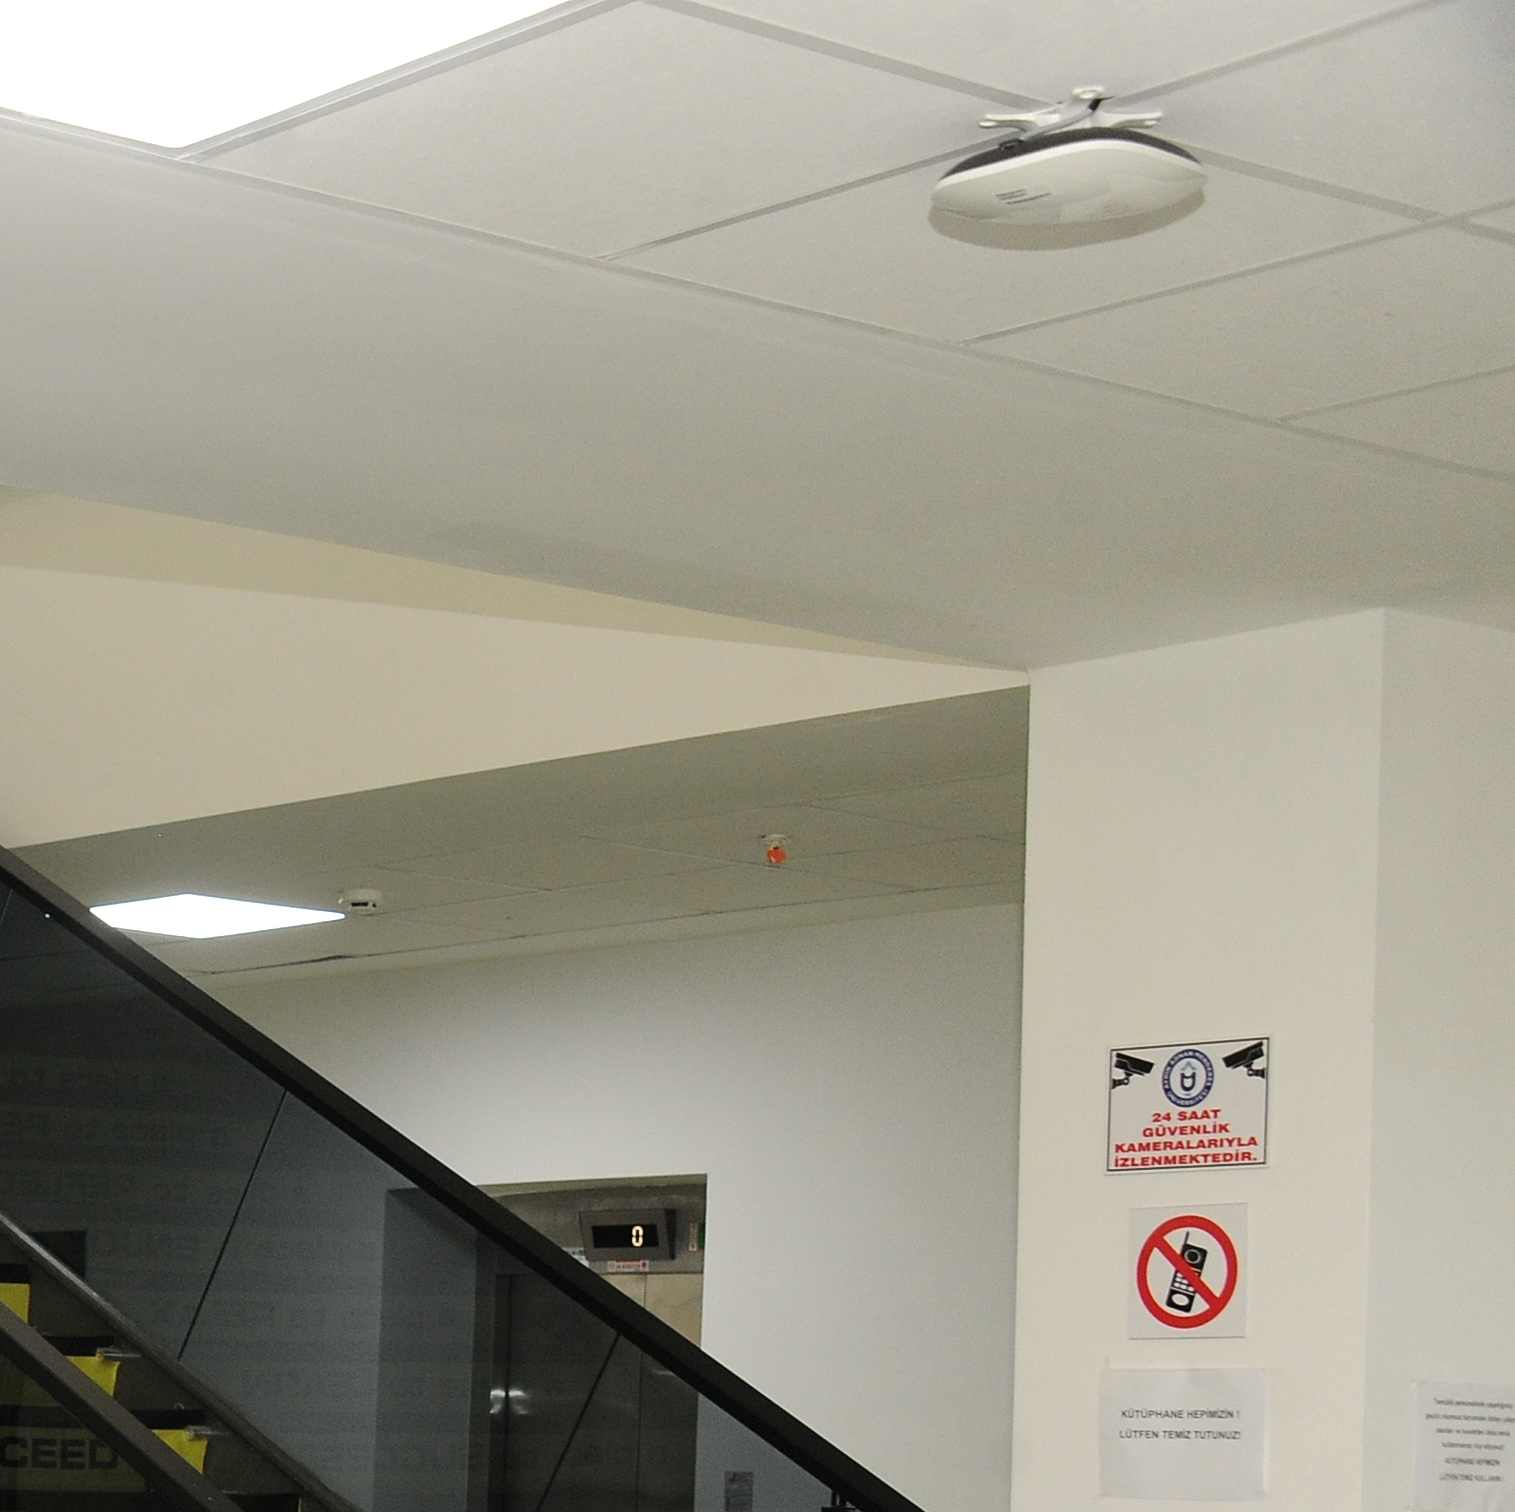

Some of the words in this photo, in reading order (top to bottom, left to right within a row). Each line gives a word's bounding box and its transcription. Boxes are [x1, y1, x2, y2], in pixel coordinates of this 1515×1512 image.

[1152, 1112, 1171, 1123] 24
[1178, 1109, 1221, 1121] SAAT
[1142, 1122, 1230, 1138] GÜVENLİK
[1114, 1136, 1258, 1153] KAMERALARIYLA
[1114, 1150, 1257, 1168] İZLENMEKTEDİR.
[632, 1225, 644, 1247] 0
[1121, 1407, 1184, 1419] KÜTÜPHANE
[1119, 1428, 1159, 1440] LÜTFEN
